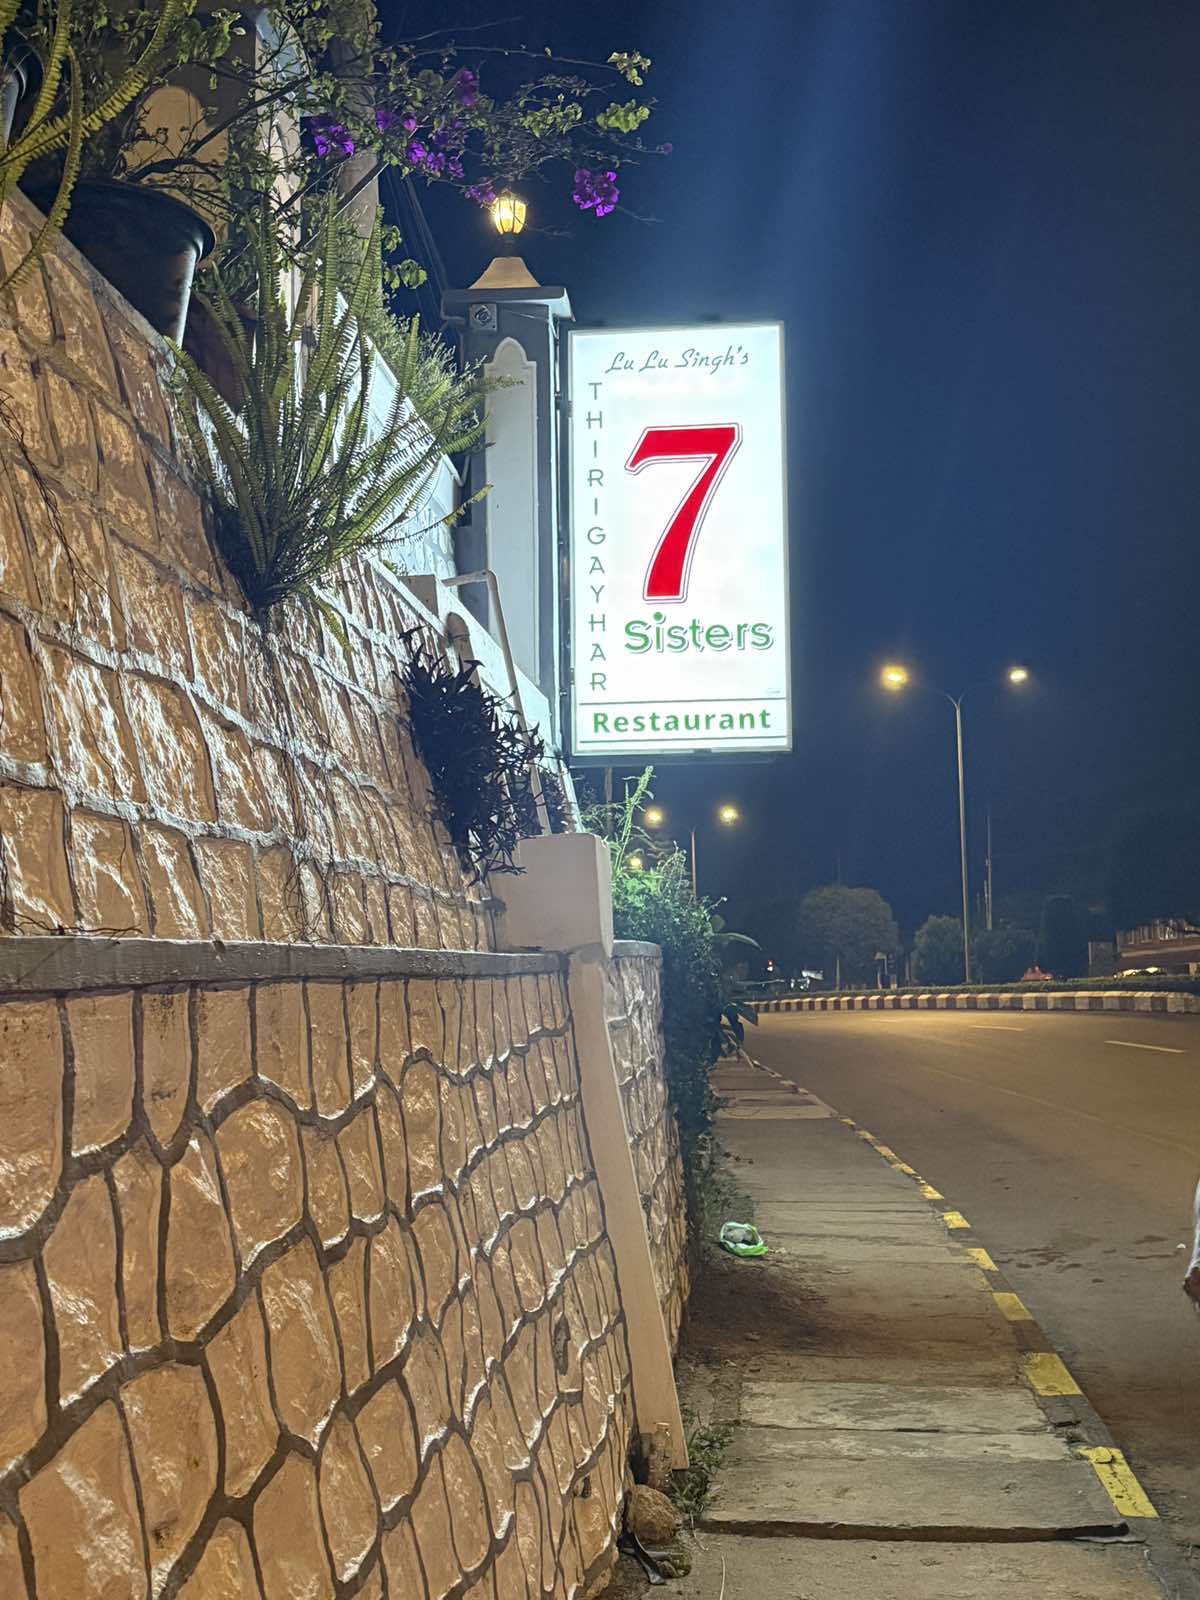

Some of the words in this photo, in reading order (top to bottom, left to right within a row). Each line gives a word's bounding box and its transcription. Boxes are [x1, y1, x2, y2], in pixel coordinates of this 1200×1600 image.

[605, 352, 634, 374] Lu
[638, 350, 669, 373] Lu
[674, 345, 749, 375] Singh's
[624, 422, 743, 603] 7
[586, 382, 607, 691] THIRIGAYHAR
[624, 611, 774, 654] Sisters
[592, 708, 771, 734] Restaurant
